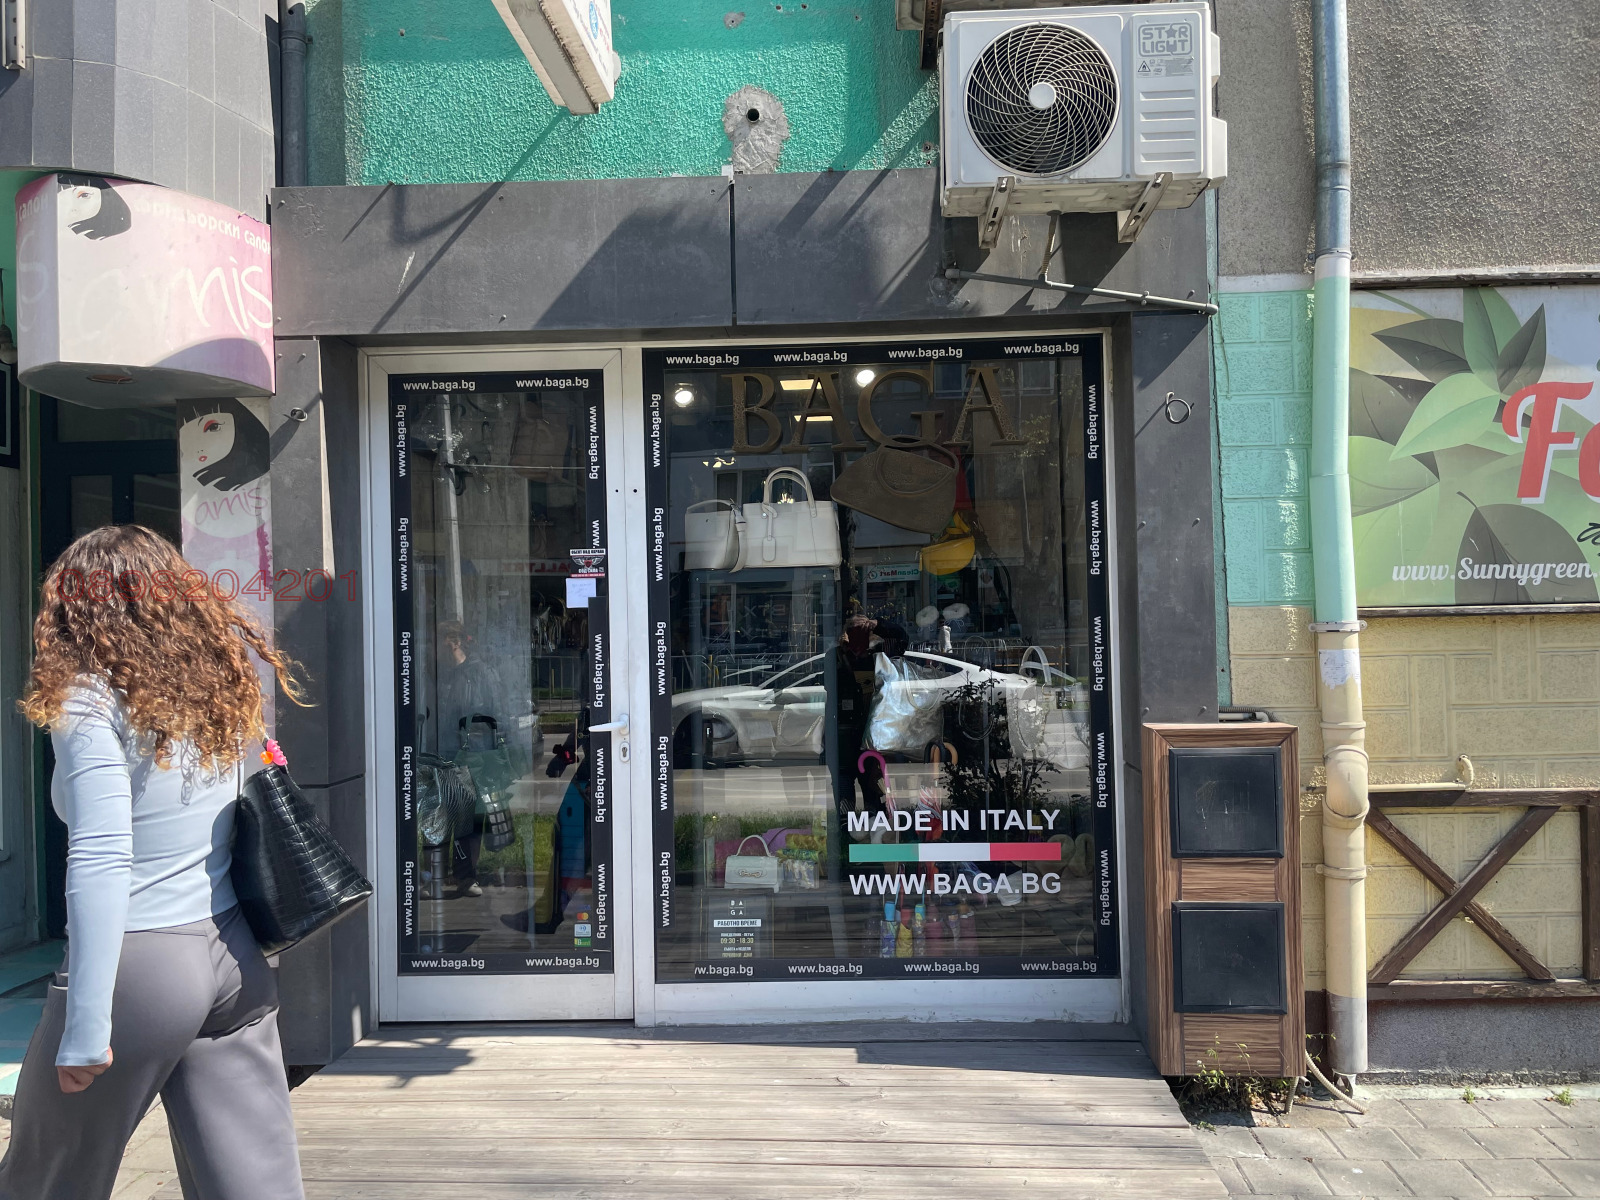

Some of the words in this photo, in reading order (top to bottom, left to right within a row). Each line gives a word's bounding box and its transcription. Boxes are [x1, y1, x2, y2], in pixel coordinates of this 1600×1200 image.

[1142, 39, 1188, 53] LIGHT
[403, 379, 476, 392] www.baga.bg
[515, 376, 589, 389] www.baga.bg
[665, 353, 740, 366] www.baga.bg
[773, 350, 848, 363] www.baga.bg
[888, 346, 963, 360] www.baga.bg
[1003, 342, 1080, 355] www.baga.bg
[395, 404, 407, 478] www.baga.bg
[588, 405, 601, 480] www.baga.bg
[649, 393, 662, 468] www.baga.bg
[721, 367, 1027, 454] BAGA
[1086, 384, 1100, 459] www.baga.bg
[194, 486, 269, 526] amis
[1089, 499, 1103, 575] www.baga.bg
[397, 517, 410, 592] www.baga.bg
[652, 507, 665, 582] www.baga.bg
[399, 631, 412, 706] www.baga.bg
[593, 633, 605, 708] www.baga.bg
[654, 621, 667, 696] www.baga.bg
[1092, 615, 1106, 691] www.baga.bg
[401, 746, 413, 821] www.baga.bg
[594, 747, 607, 823] www.baga.bg
[657, 736, 670, 811] www.baga.bg
[1095, 732, 1109, 808] www.baga.bg
[847, 809, 932, 832] MADE
[942, 810, 969, 831] IN
[980, 809, 1061, 831] ITALY
[403, 861, 415, 936] www.baga.bg
[596, 863, 608, 939] www.baga.bg
[659, 851, 672, 927] www.baga.bg
[848, 872, 1061, 896] WWW.BAGA.BG
[1099, 849, 1113, 926] www.baga.bg
[411, 957, 485, 970] www.baga.bg
[525, 955, 600, 968] www.baga.bg
[788, 962, 863, 975] www.baga.bg
[903, 961, 980, 974] www.baga.bg
[1020, 960, 1097, 973] www.baga.bg
